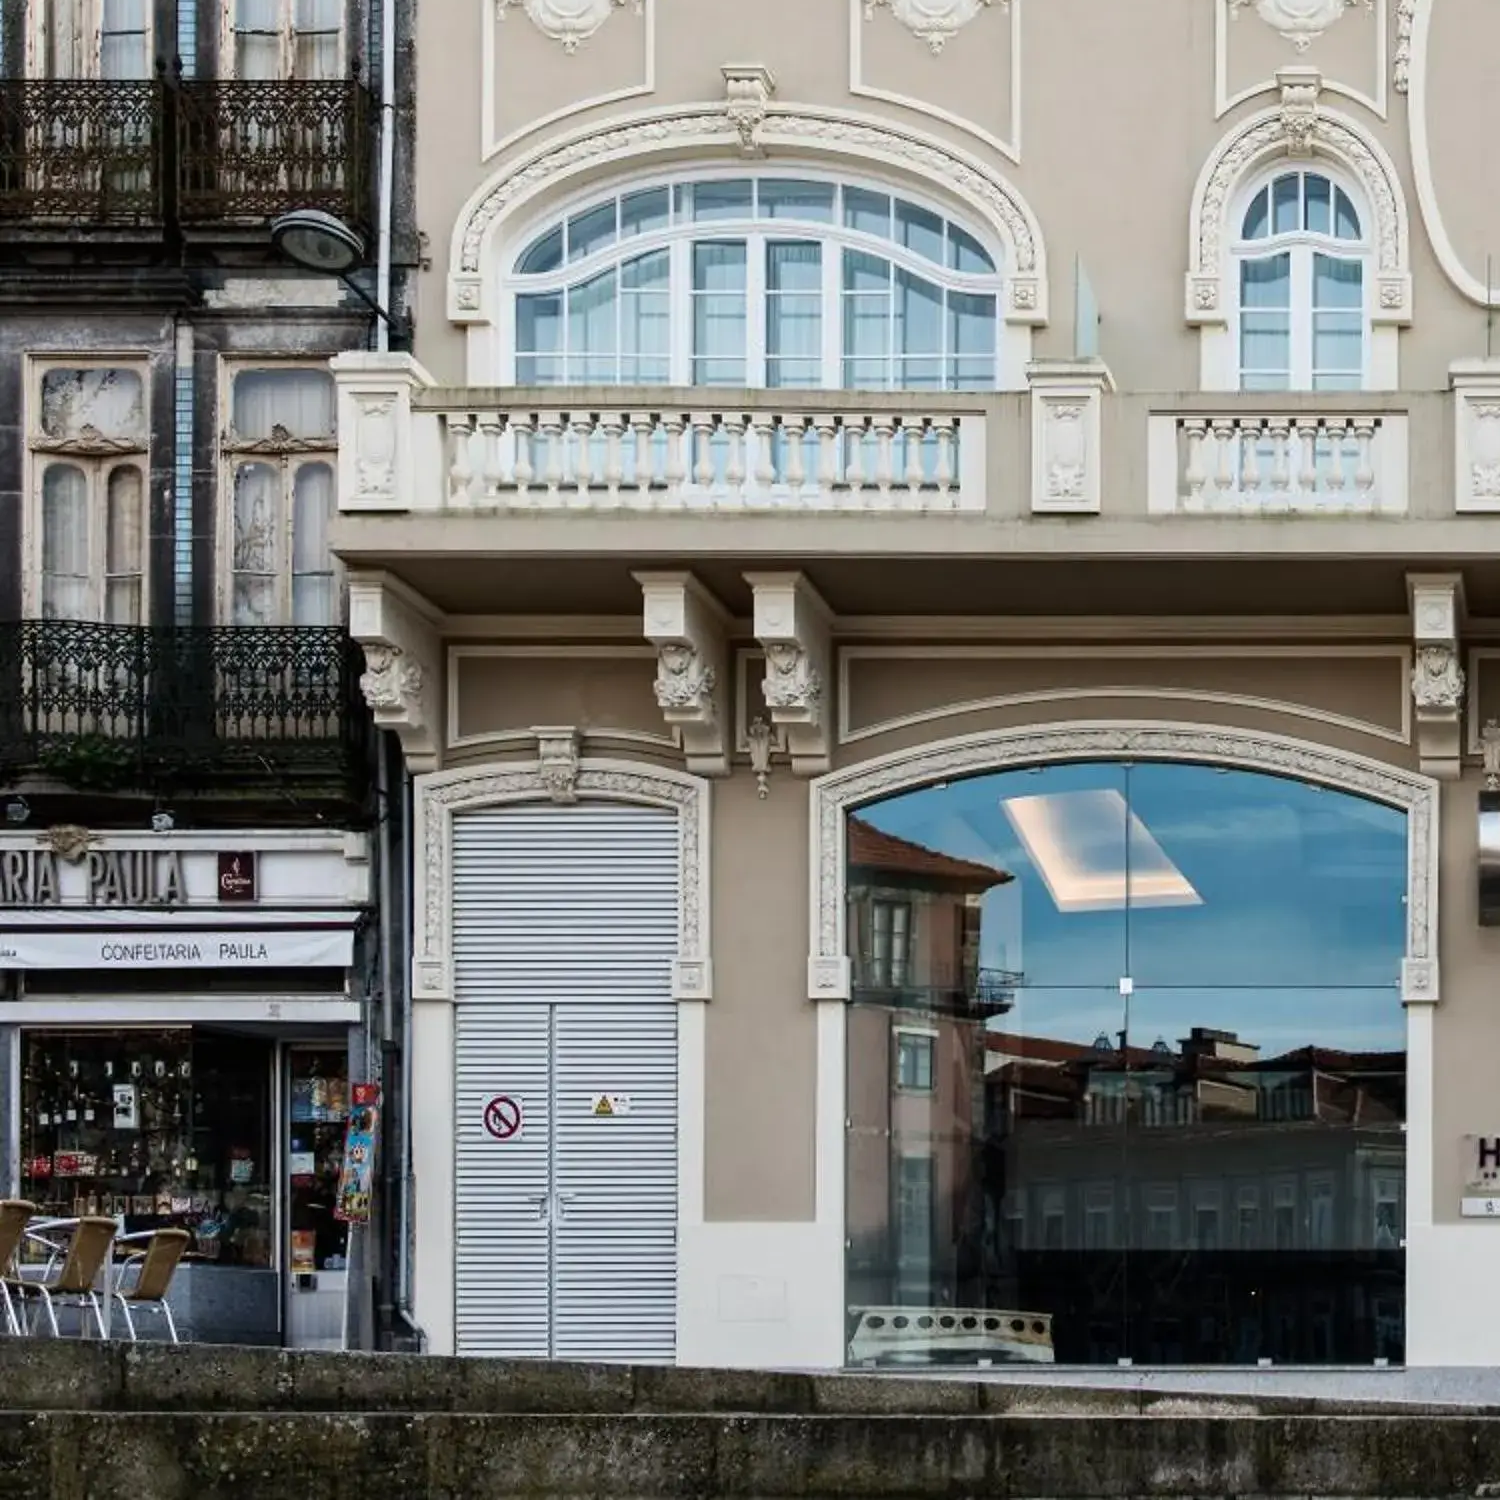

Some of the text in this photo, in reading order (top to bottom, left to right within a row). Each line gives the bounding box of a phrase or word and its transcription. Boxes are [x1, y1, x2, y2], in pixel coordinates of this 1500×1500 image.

[0, 850, 188, 904] RIA PAULA
[101, 943, 268, 961] CONFEITARIA PAULA
